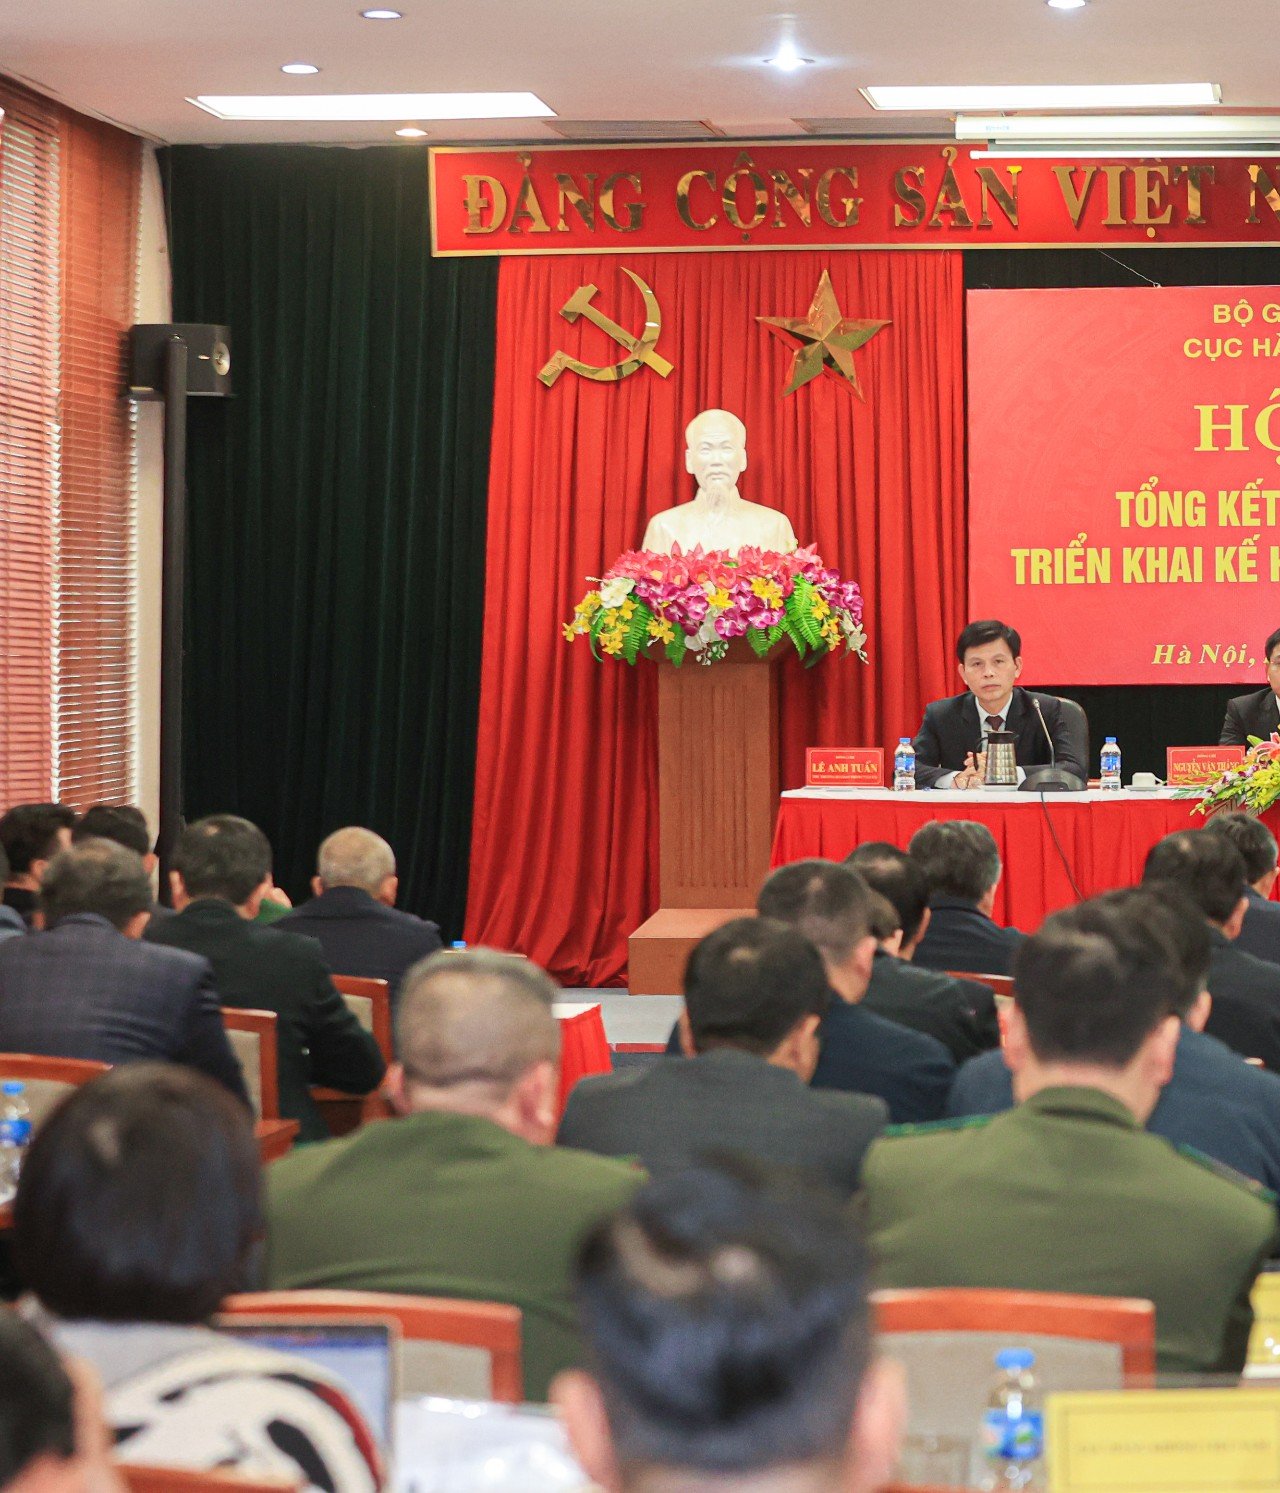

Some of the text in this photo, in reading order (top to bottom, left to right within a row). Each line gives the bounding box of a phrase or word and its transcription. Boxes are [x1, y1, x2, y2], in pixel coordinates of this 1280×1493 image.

[461, 151, 645, 234] ĐẢNG
[676, 150, 864, 242] CỘNG
[893, 146, 1023, 229] SẢN
[1052, 158, 1215, 238] VIỆT
[1213, 299, 1254, 328] BỘ
[1183, 337, 1242, 363] CỤC
[1115, 476, 1207, 529] TỔNG
[1217, 478, 1280, 527] KẾT
[1011, 532, 1112, 585] TRIỂN
[1122, 545, 1204, 584] KHAI
[1214, 533, 1260, 583] KẾ
[1152, 643, 1192, 665] Hà
[1199, 643, 1256, 667] Nội,
[812, 760, 878, 773] LÊ ANH TUẤN
